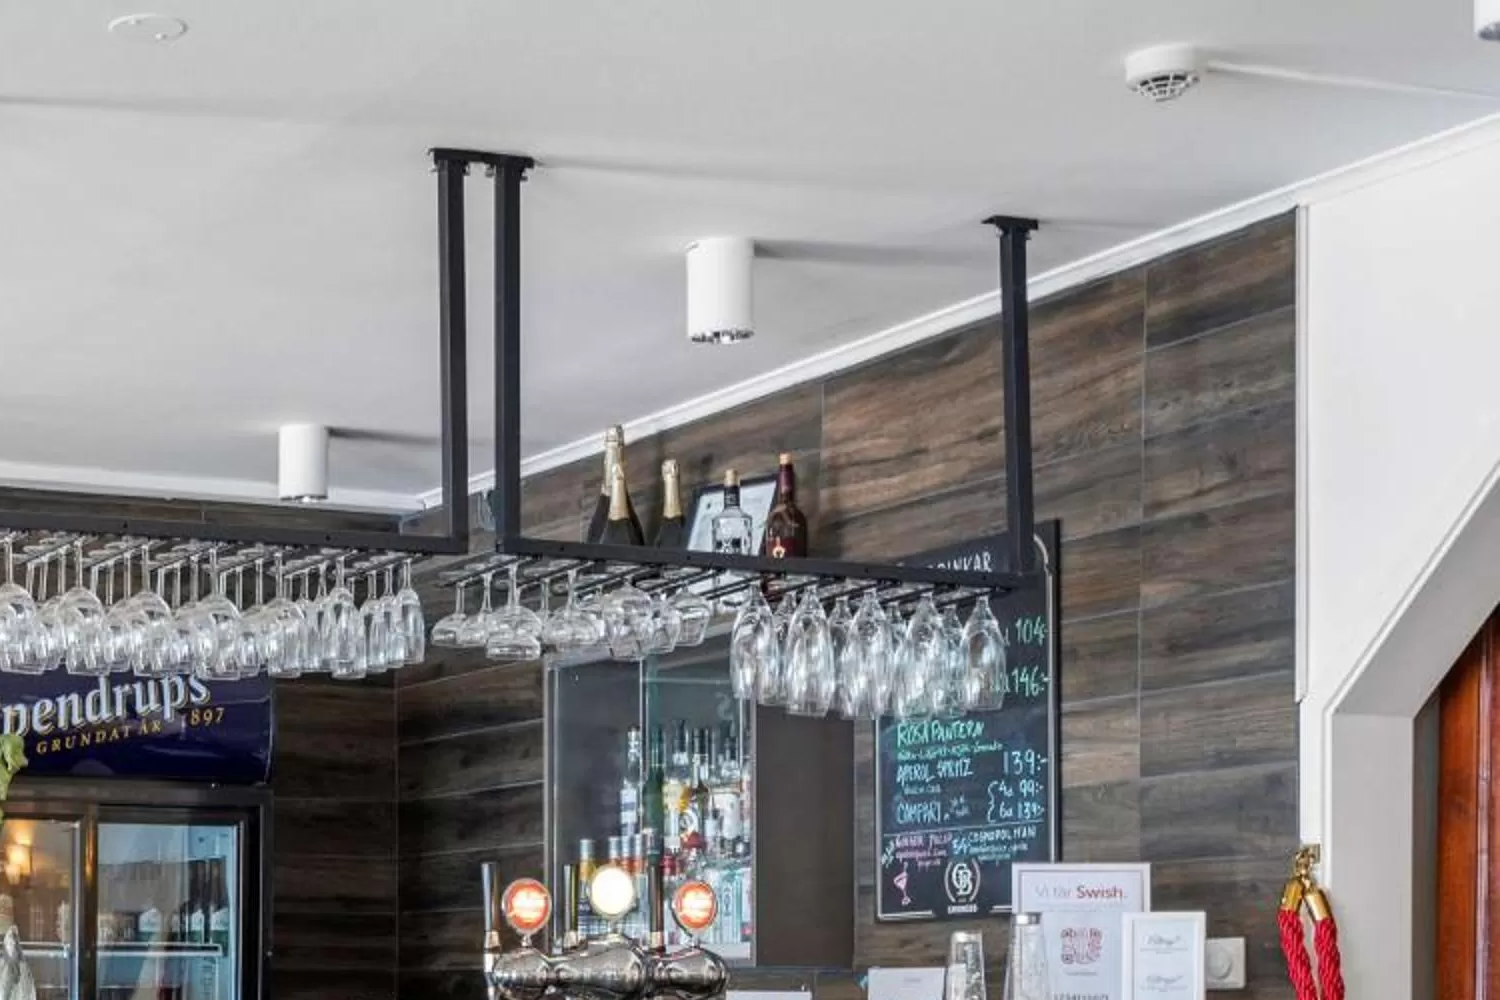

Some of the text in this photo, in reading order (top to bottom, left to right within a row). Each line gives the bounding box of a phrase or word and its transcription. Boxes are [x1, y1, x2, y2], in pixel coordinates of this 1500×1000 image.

[36, 725, 130, 754] GRUNDAT
[1002, 749, 1047, 775] 139:-
[1075, 883, 1125, 899] Swish
